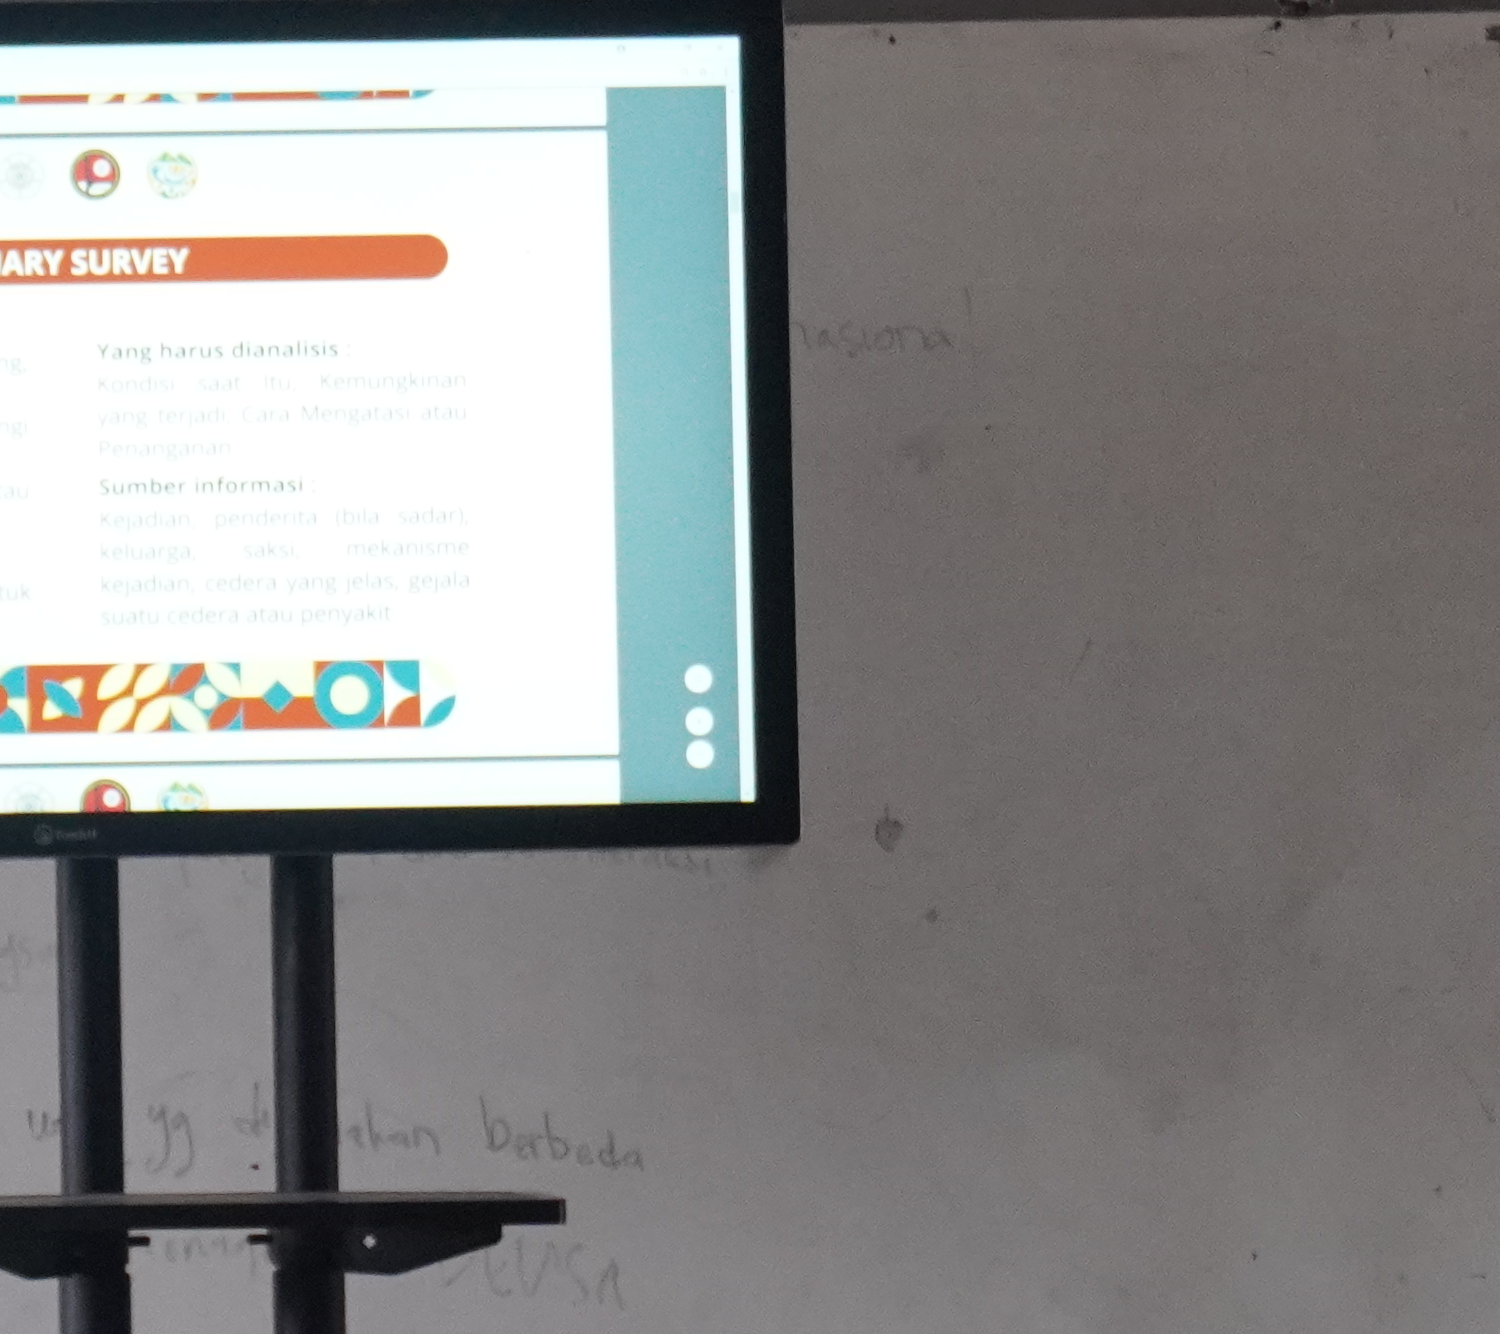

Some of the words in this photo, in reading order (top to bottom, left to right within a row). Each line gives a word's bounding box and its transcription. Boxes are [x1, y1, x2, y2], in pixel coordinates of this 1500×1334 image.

[69, 245, 191, 277] SURVEY
[96, 343, 152, 366] Yang
[159, 341, 224, 361] harus
[231, 339, 340, 360] dianalisis
[96, 374, 176, 394] Kondisi
[197, 375, 242, 394] saat
[319, 371, 468, 396] Kemungkinan
[97, 409, 150, 430] yang
[241, 405, 291, 424] Cara
[300, 403, 412, 430] Mengatasi
[420, 405, 469, 423] atau
[98, 439, 232, 463] Penanganan
[98, 478, 186, 497] Sumber
[194, 475, 305, 495] informasi
[213, 509, 319, 532] penderita
[346, 539, 471, 559] mekanisme
[204, 572, 278, 593] cedera
[285, 574, 338, 597] yang
[407, 569, 472, 595] gejala
[100, 608, 161, 627] suatu
[166, 605, 241, 626] cedera
[245, 605, 294, 626] atau
[300, 602, 393, 629] penyakit
